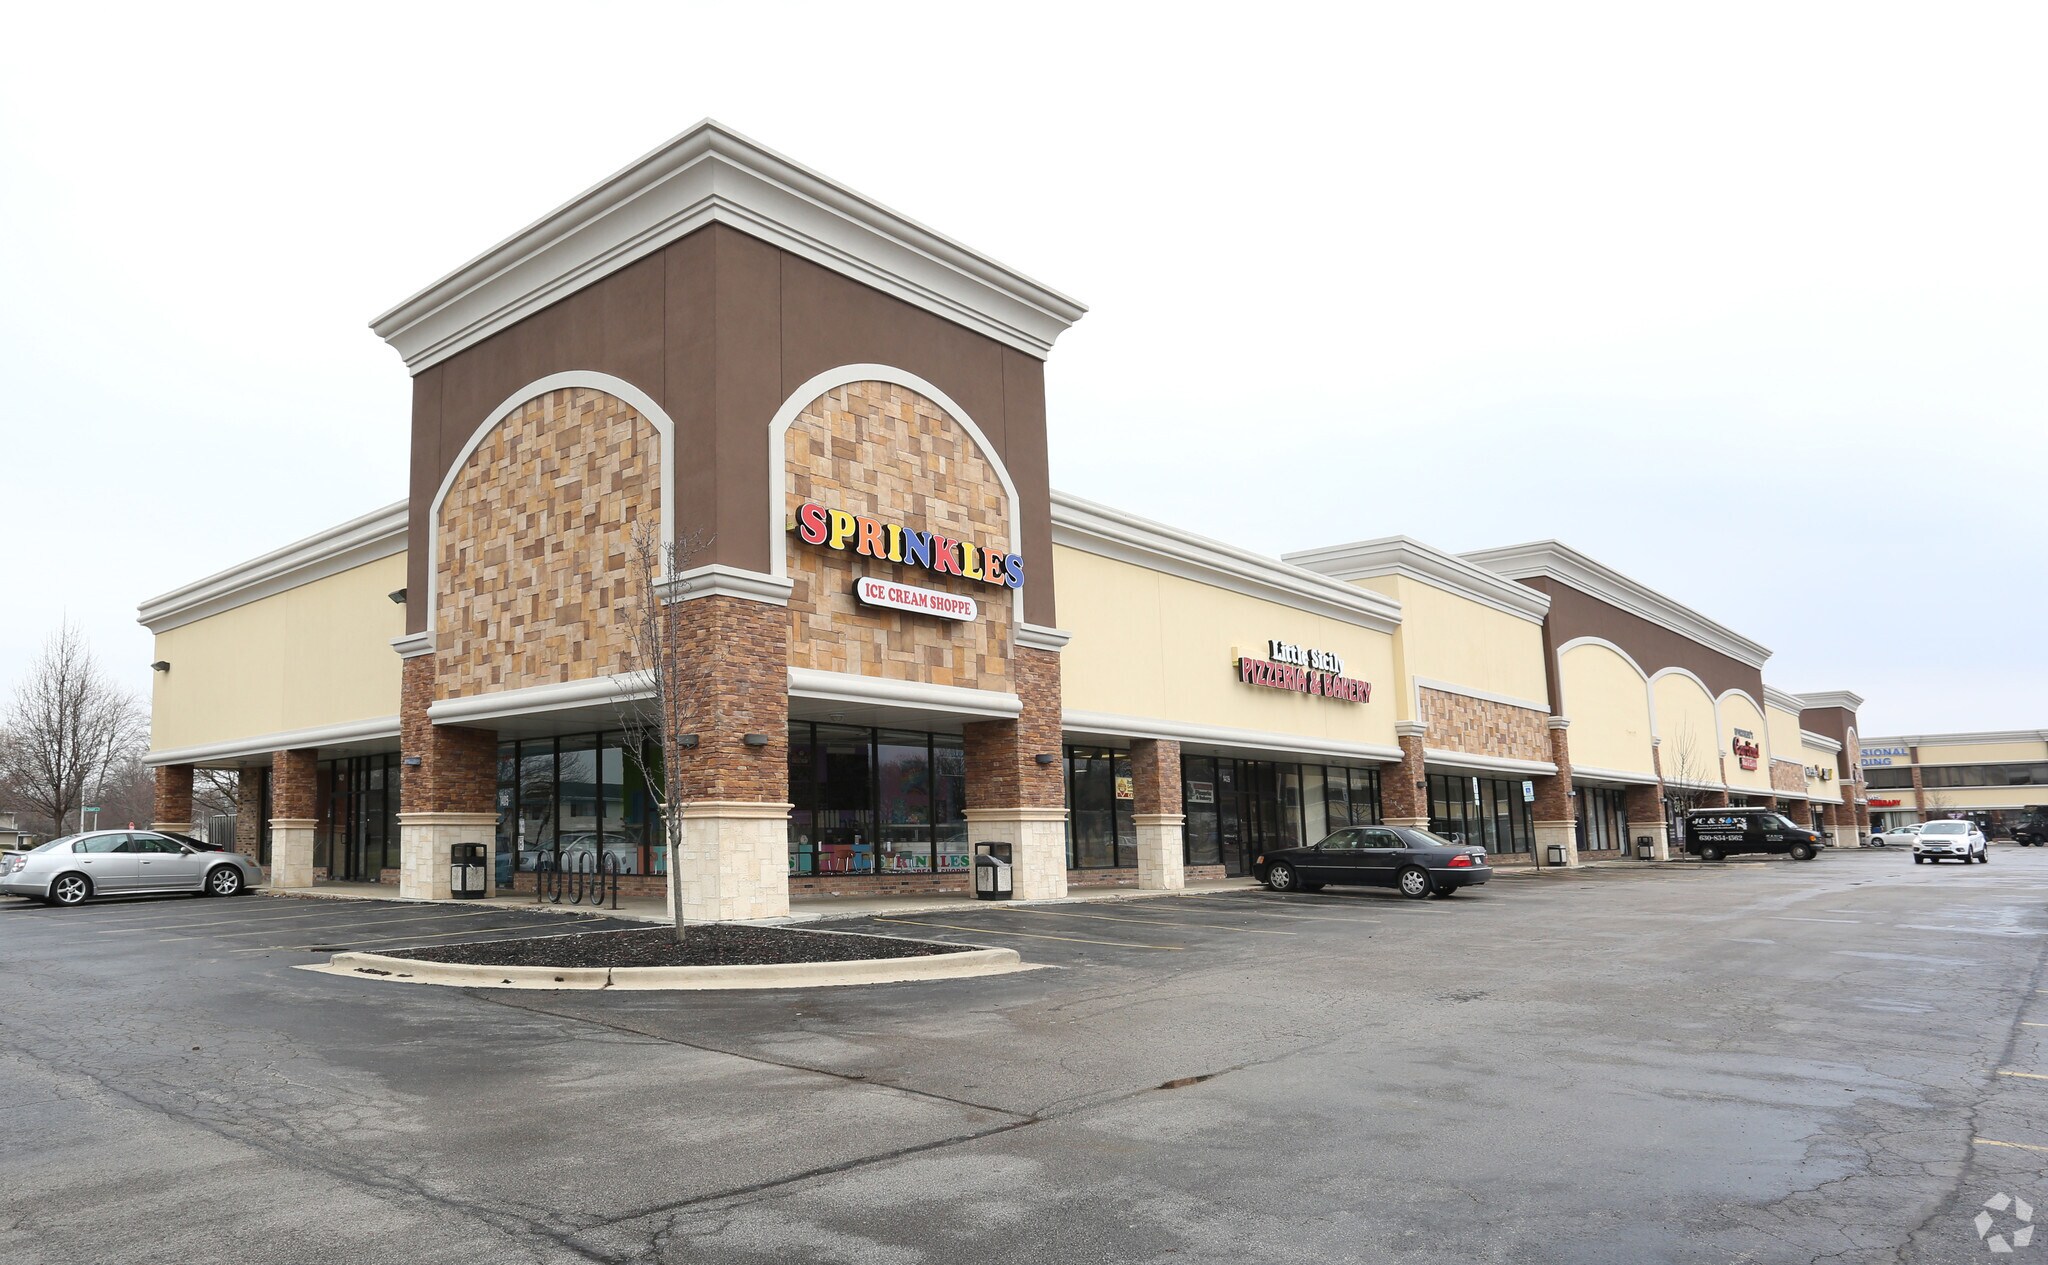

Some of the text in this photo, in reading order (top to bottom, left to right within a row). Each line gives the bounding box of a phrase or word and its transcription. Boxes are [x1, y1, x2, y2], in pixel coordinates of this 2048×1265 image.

[798, 502, 1025, 589] SPRINKLES
[865, 582, 972, 616] ICE CREAM SHOPPE
[1241, 657, 1372, 703] PIZZERIA & BAKERY
[1269, 639, 1345, 679] Little Sicily
